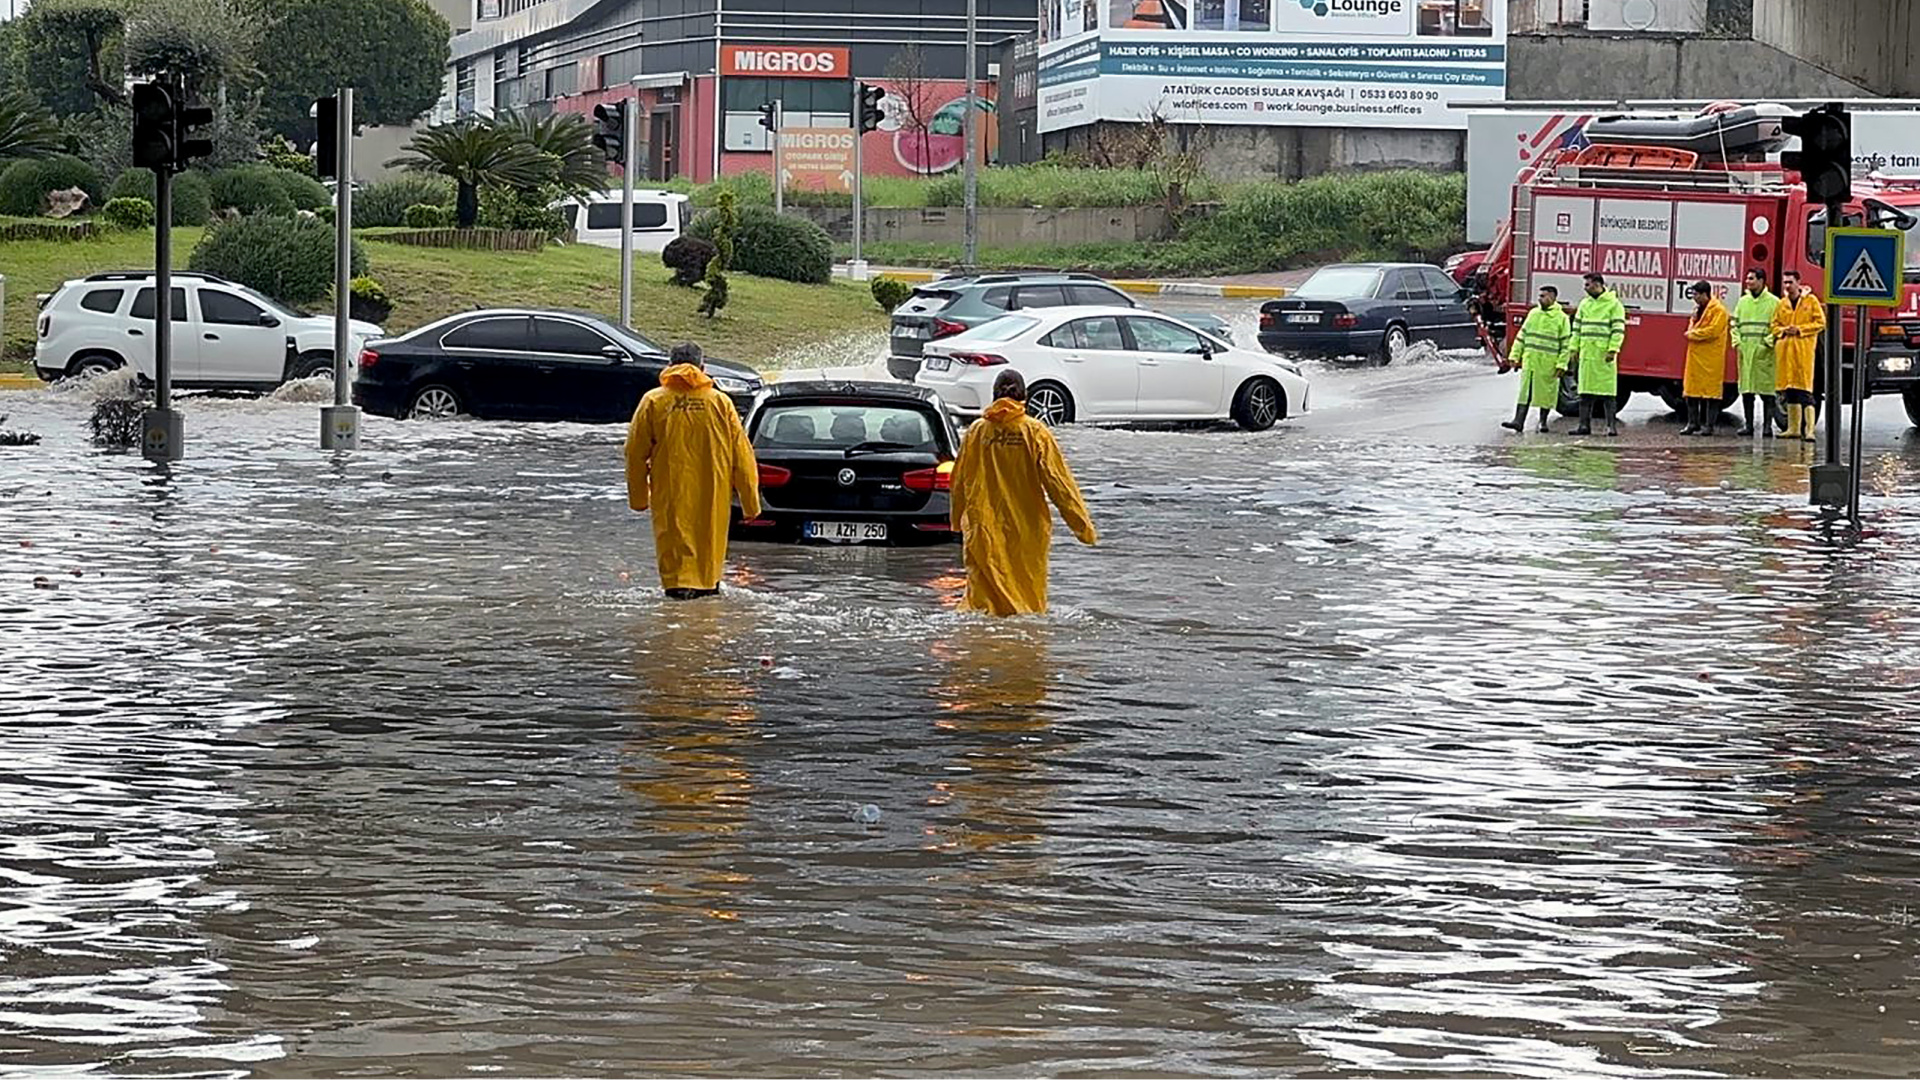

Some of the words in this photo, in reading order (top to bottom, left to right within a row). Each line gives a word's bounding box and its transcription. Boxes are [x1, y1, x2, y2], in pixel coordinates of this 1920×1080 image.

[1331, 0, 1401, 15] Lounge
[1109, 47, 1137, 56] HAZIR
[1138, 45, 1159, 56] OFİS
[1168, 46, 1200, 58] KİŞİSEL
[1202, 47, 1230, 56] MASA
[1236, 48, 1250, 56] CO
[1252, 48, 1298, 56] WORKING
[1306, 48, 1336, 56] SANAL
[1338, 46, 1358, 56] OFİS
[1367, 48, 1412, 57] TOPLANTI
[1413, 48, 1450, 57] SALONU
[1458, 48, 1487, 58] TERAS
[1247, 66, 1283, 77] Soğutma
[1162, 84, 1212, 95] ATATÜRK
[1214, 85, 1260, 96] CADDESİ
[1262, 86, 1294, 96] SULAR
[1296, 87, 1344, 100] KAVŞAĞI
[1360, 90, 1386, 99] 0533
[1388, 90, 1408, 100] 603
[1410, 90, 1424, 100] 80
[1426, 91, 1438, 100] 90
[1266, 101, 1422, 114] work.lounge.business.offices
[1850, 152, 1886, 167] safe
[1534, 241, 1590, 272] İTFAİYE
[1602, 249, 1662, 276] ARAMA
[1678, 252, 1737, 279] KURTARMA
[1606, 282, 1664, 300] ANKUR
[811, 522, 824, 536] 01
[836, 523, 857, 537] AZH
[864, 524, 885, 538] 250
